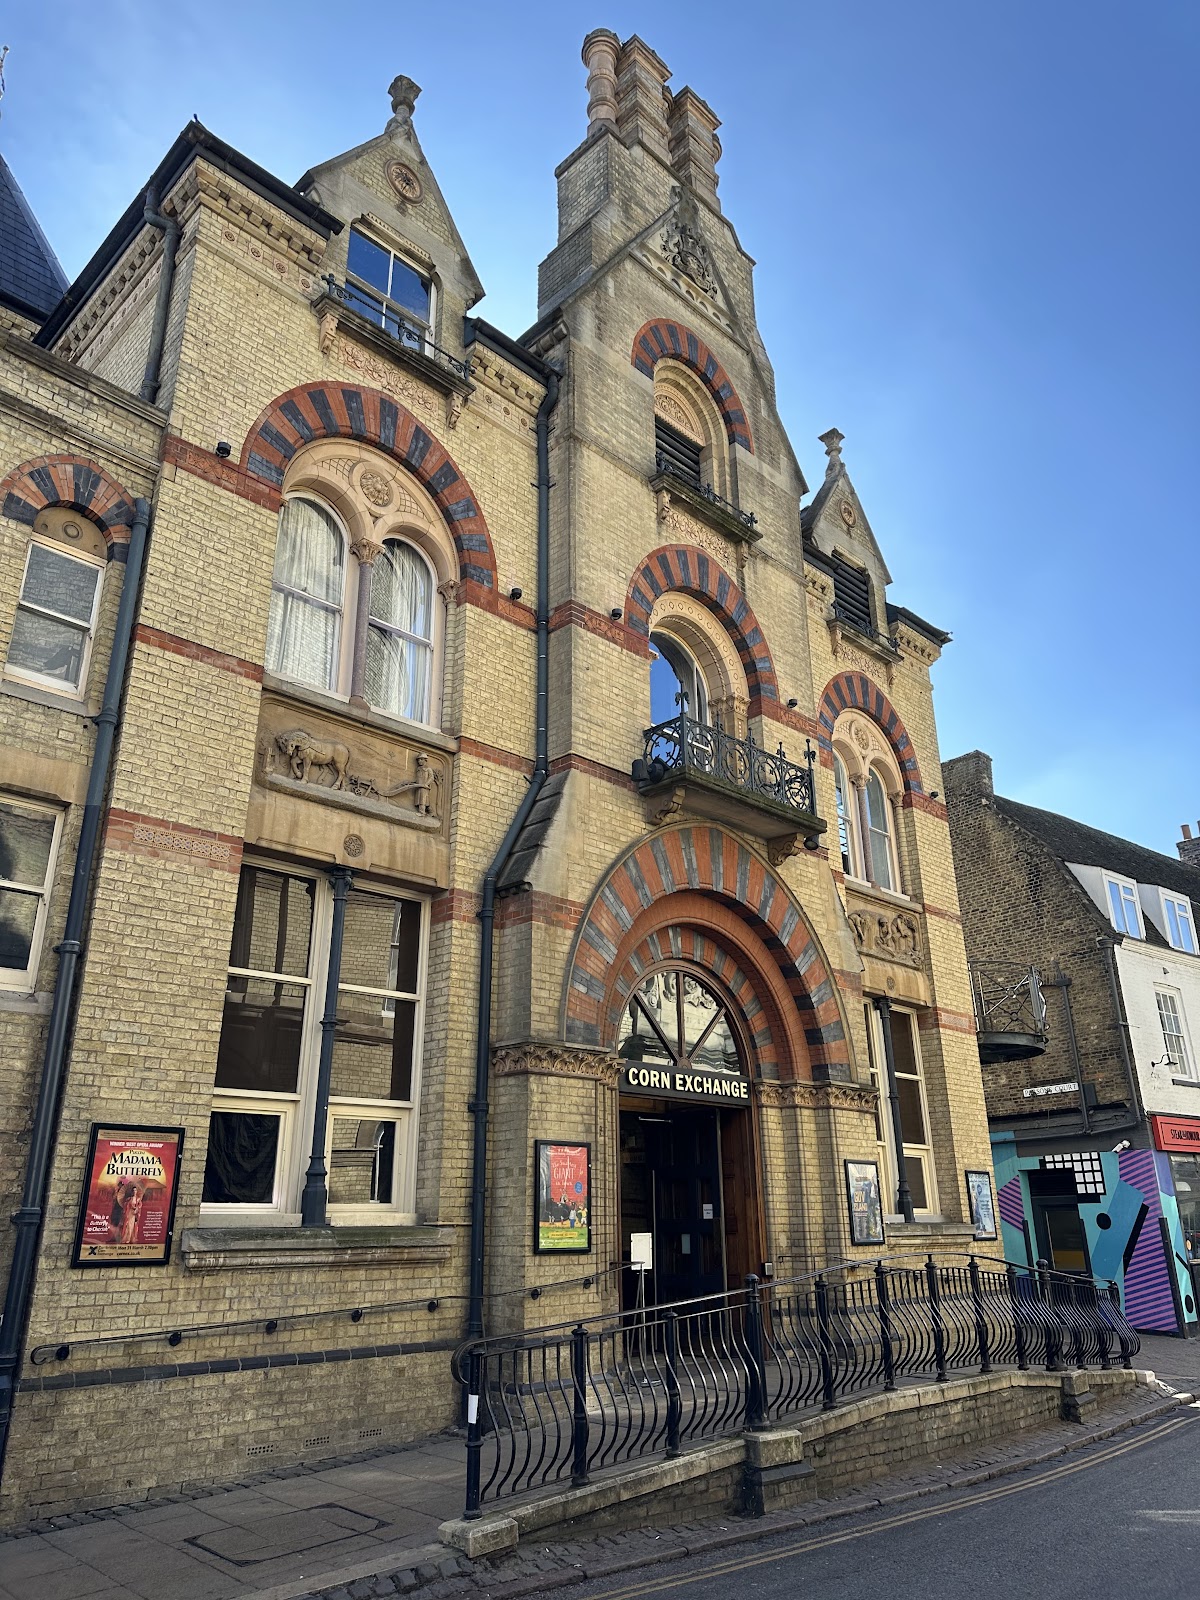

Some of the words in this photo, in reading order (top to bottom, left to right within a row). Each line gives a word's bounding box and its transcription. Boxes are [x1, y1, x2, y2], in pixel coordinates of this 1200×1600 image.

[628, 1067, 671, 1089] CORN
[675, 1073, 748, 1099] EXCHANGE
[1025, 1087, 1052, 1096] PSON
[1054, 1084, 1076, 1093] COURT
[110, 1152, 162, 1165] MADAMA
[106, 1164, 164, 1177] BUTTERFLY
[553, 1168, 575, 1179] GIANT
